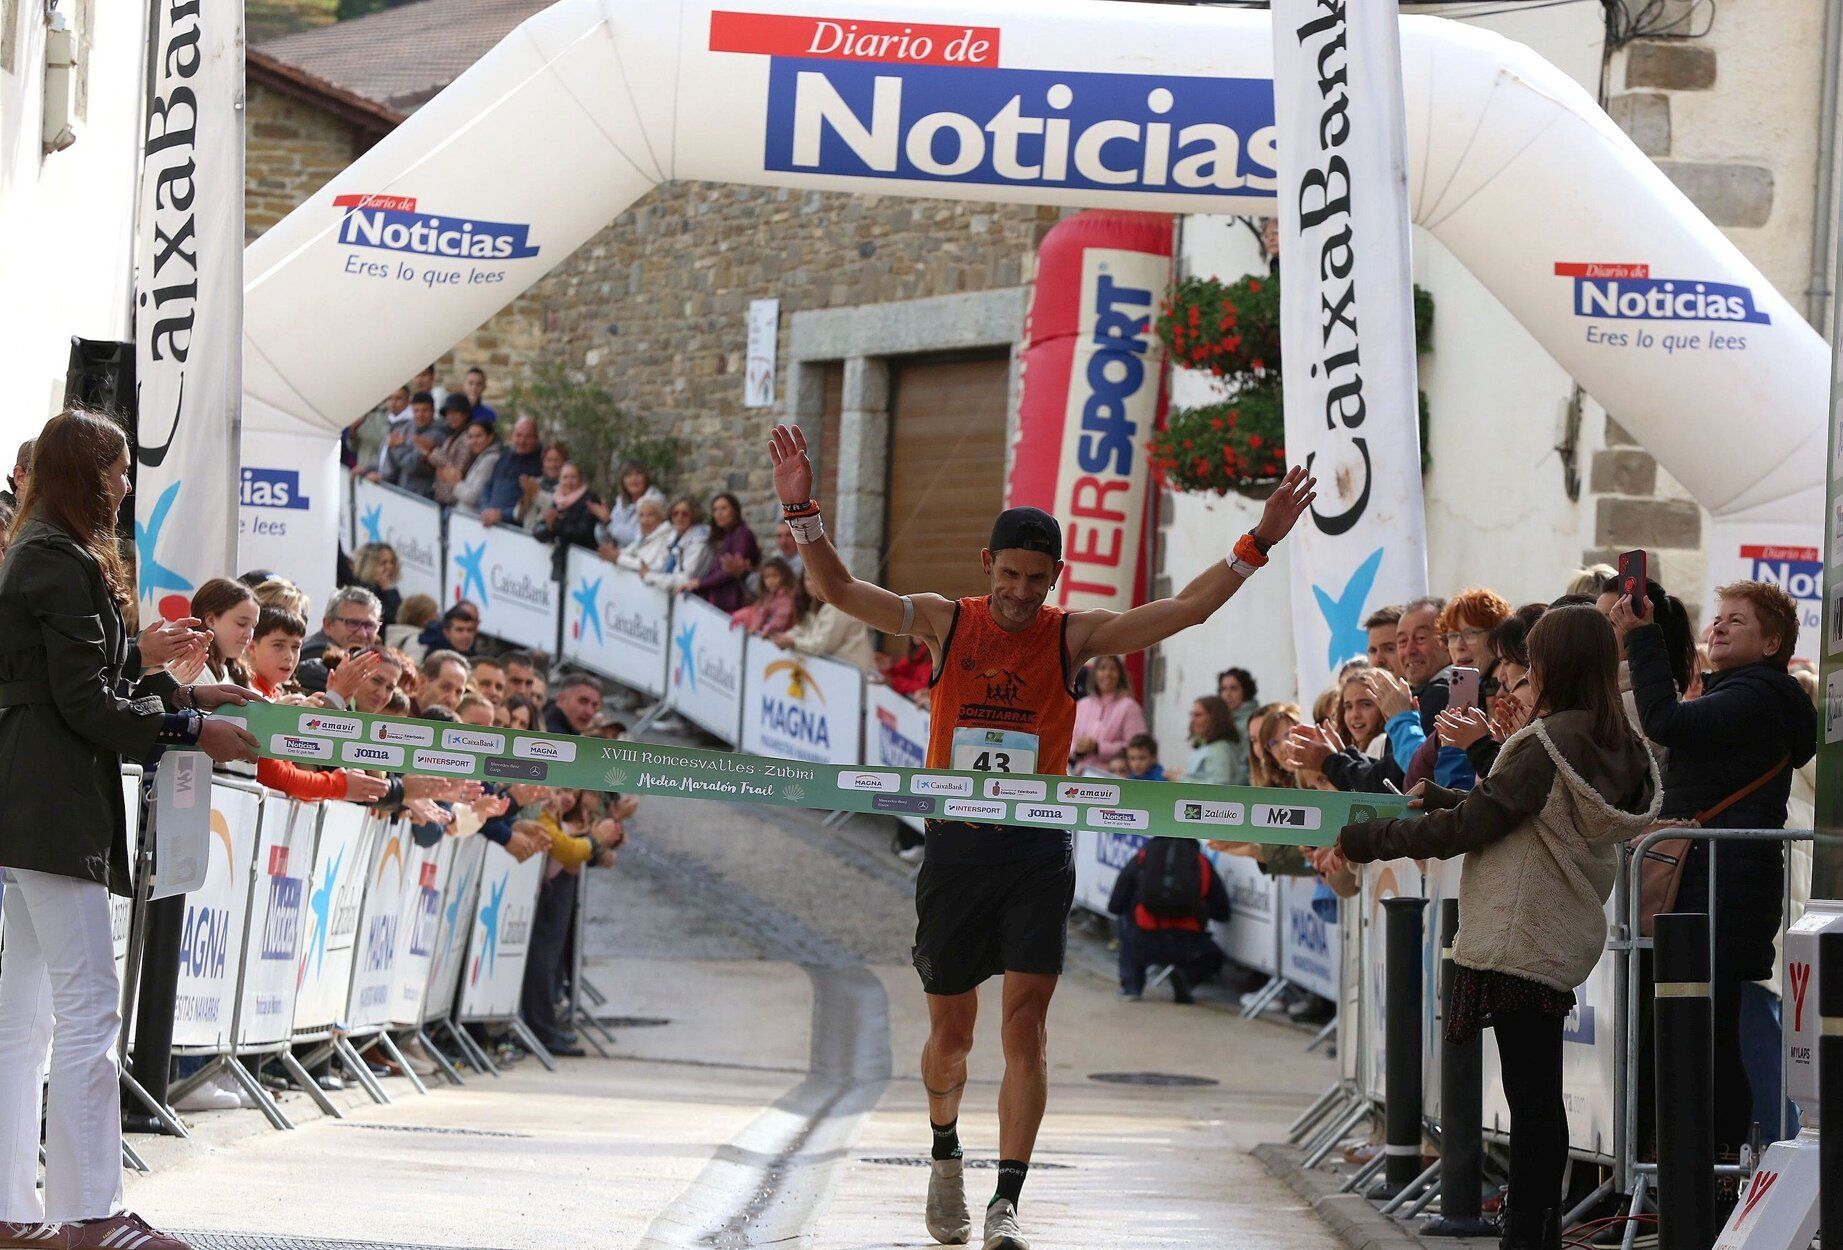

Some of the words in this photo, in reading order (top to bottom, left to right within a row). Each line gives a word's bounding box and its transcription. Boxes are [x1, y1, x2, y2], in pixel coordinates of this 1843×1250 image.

[807, 21, 932, 61] Diario
[945, 29, 990, 63] de
[792, 71, 1278, 191] Noticias
[358, 194, 396, 209] Diario
[398, 197, 414, 212] de
[346, 209, 514, 258] Noticias
[344, 254, 388, 278] Eres
[397, 261, 414, 281] lo
[423, 268, 461, 288] que
[468, 267, 506, 284] lees
[1298, 0, 1372, 536] CaixaBank
[1585, 264, 1628, 277] Diario
[1630, 265, 1647, 278] de
[1581, 280, 1746, 321] Noticias
[1586, 325, 1628, 346] Eres
[1637, 329, 1653, 348] lo
[1662, 334, 1700, 353] que
[1709, 329, 1747, 350] lees
[241, 470, 289, 507] ias
[253, 516, 287, 536] lees
[1803, 608, 1820, 627] lo
[322, 722, 356, 732] amavir
[761, 694, 830, 749] MAGNA
[287, 740, 317, 750] Noticias
[461, 737, 495, 748] CaixaBank
[530, 747, 558, 756] MAGNA
[424, 757, 470, 768] INTERSPORT
[601, 747, 637, 762] XVIII
[641, 752, 754, 773] Roncesvalles
[764, 765, 815, 780] Zubiri
[973, 751, 1010, 773] 43
[637, 772, 678, 788] Media
[679, 777, 736, 794] Maratón
[740, 781, 775, 797] Trail
[855, 779, 882, 787] MAGNA
[930, 782, 963, 791] CaixaBank
[1080, 789, 1113, 798] amavir
[955, 805, 1001, 814] INTERSPORT
[1103, 813, 1132, 821] Noticias
[1267, 808, 1291, 824] M2
[1790, 1046, 1811, 1060] MYLAPS
